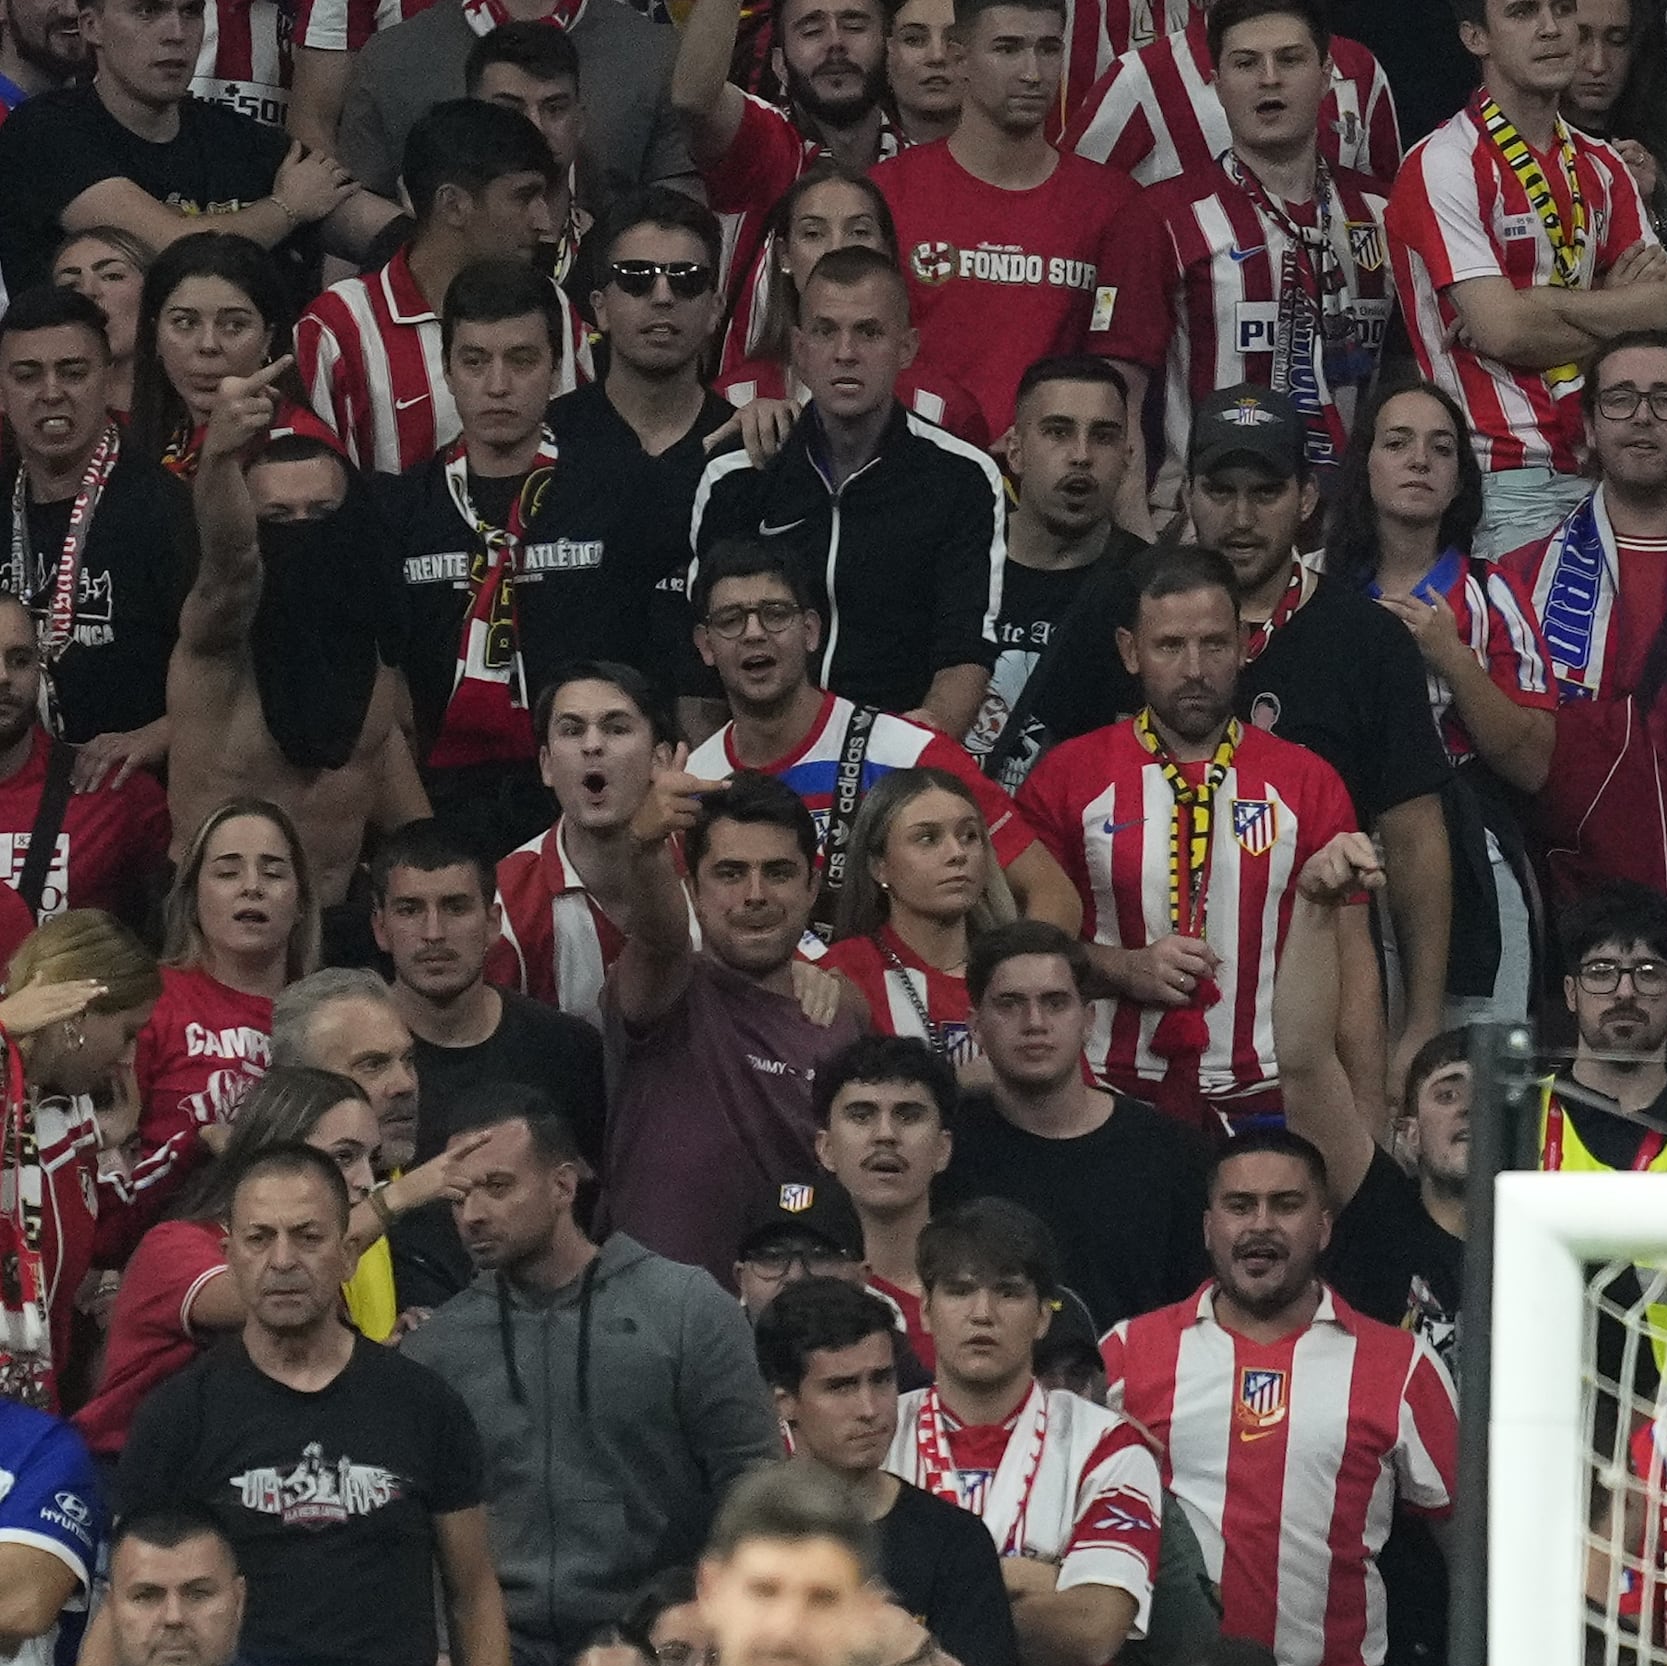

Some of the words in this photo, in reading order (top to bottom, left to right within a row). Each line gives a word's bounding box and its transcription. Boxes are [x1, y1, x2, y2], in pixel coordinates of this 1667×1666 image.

[959, 250, 1042, 285] FONDO
[525, 539, 604, 572] ATLÉTICO
[838, 736, 867, 814] adidas
